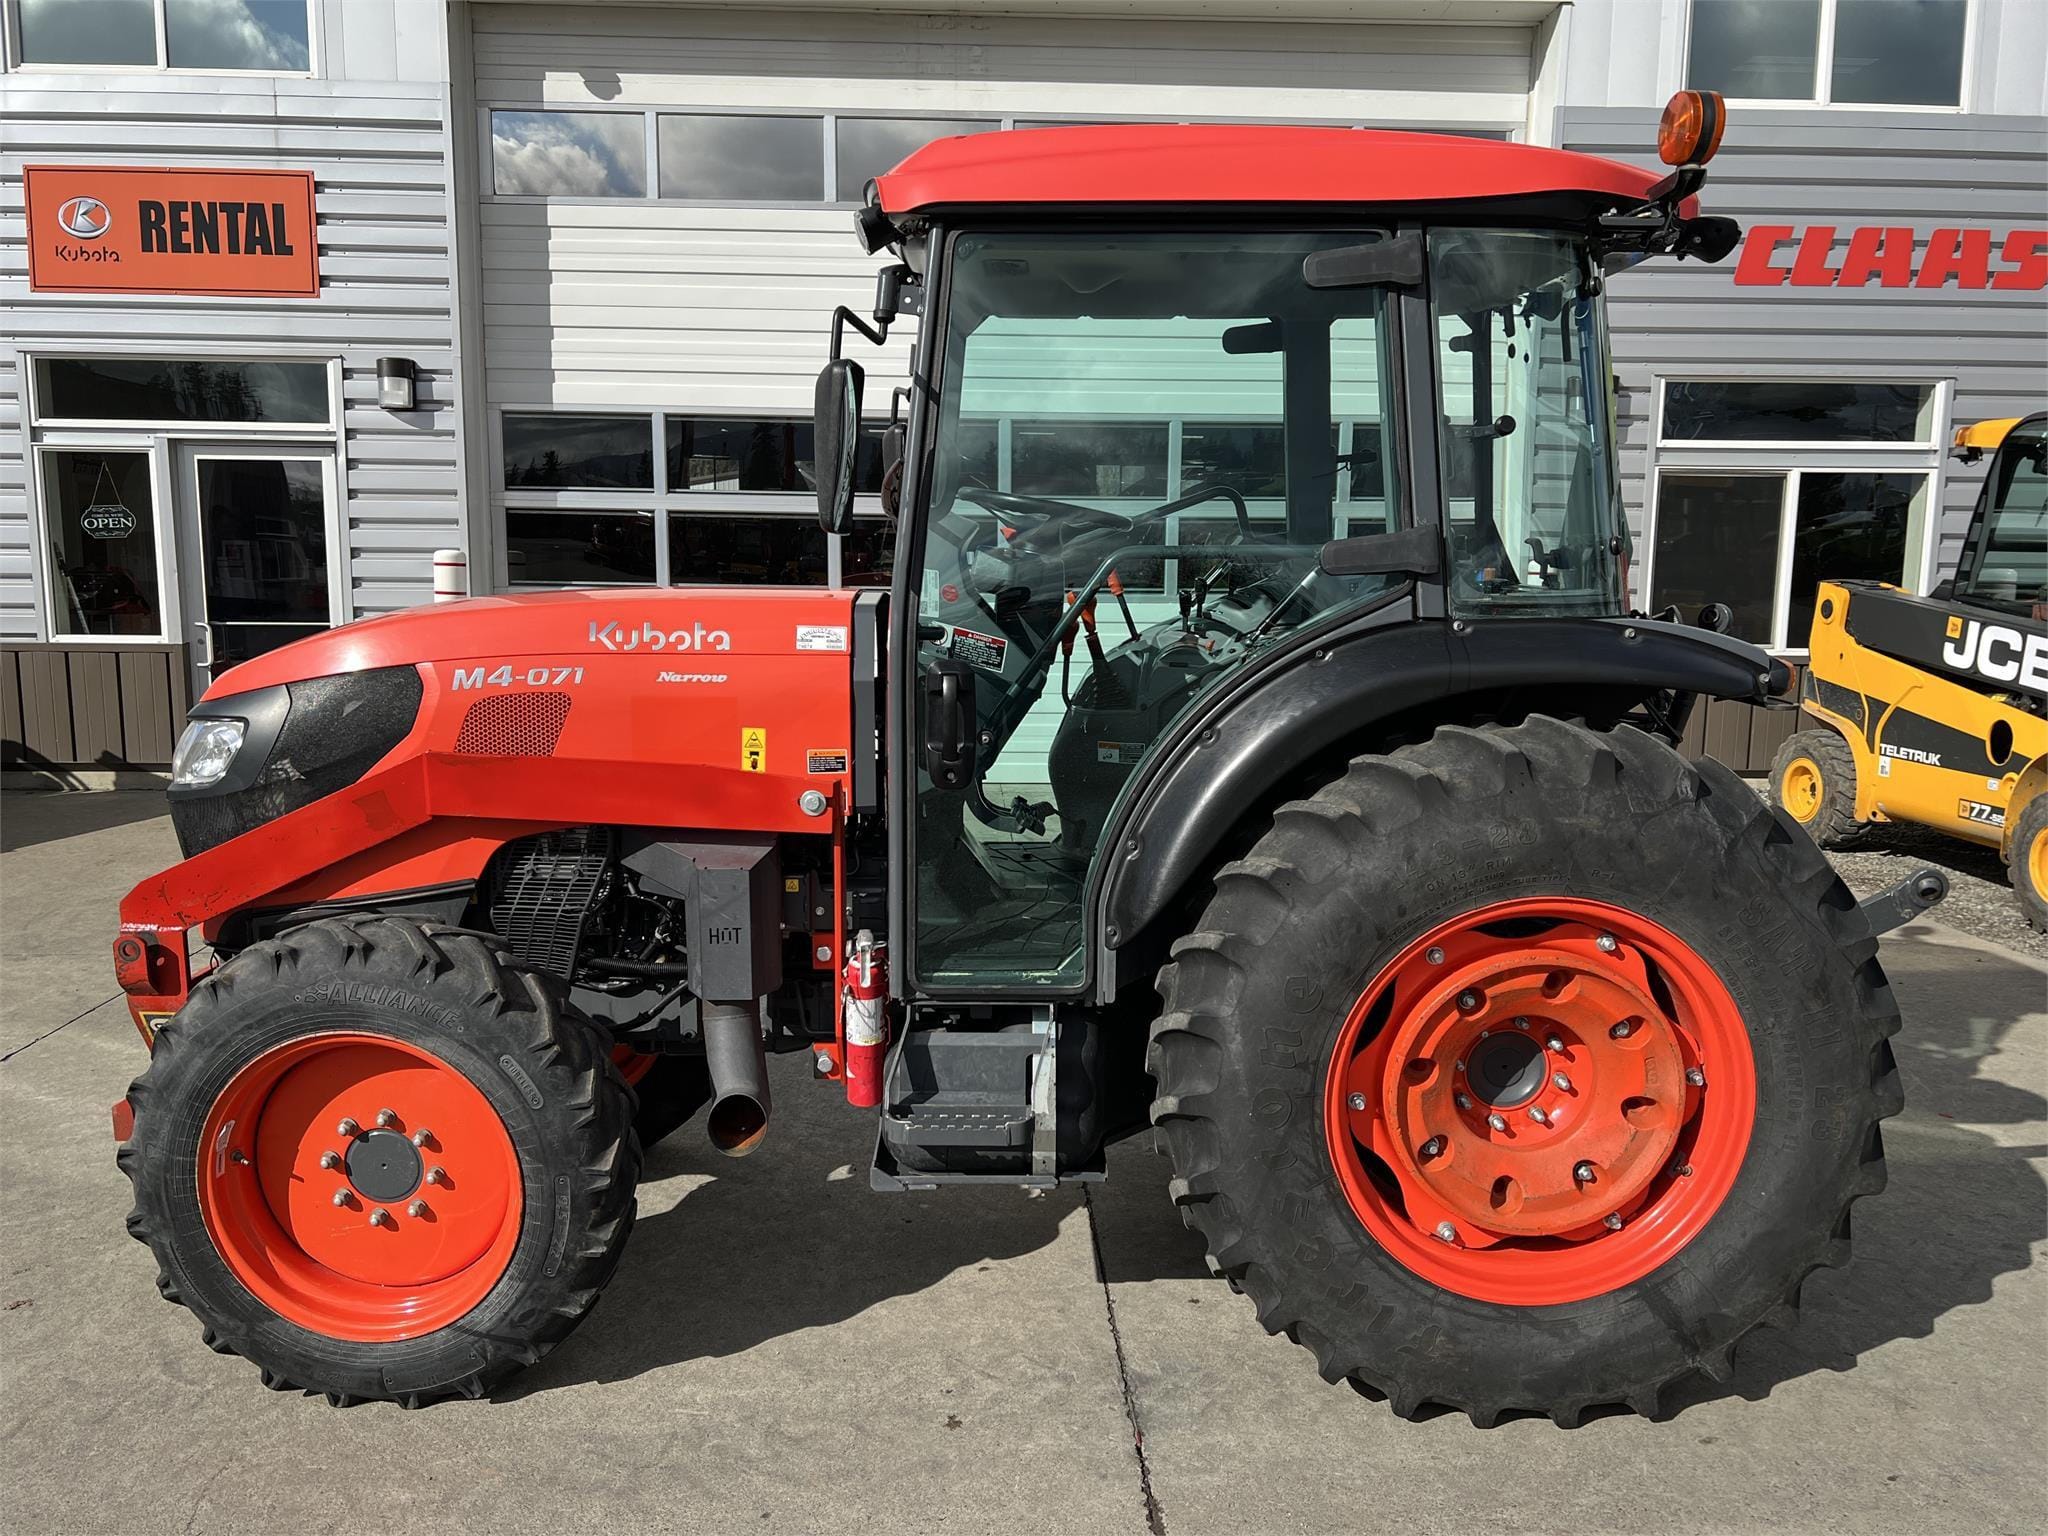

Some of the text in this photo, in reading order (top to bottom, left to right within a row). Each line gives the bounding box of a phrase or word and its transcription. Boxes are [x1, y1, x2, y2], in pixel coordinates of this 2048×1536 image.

[138, 199, 294, 256] RENTAL
[55, 245, 120, 263] Kubota
[1734, 225, 2048, 290] CLAAS
[83, 517, 133, 529] OPEN
[588, 621, 731, 651] Kubota
[1942, 620, 2048, 692] JCB
[451, 665, 584, 690] M4-071
[656, 671, 728, 683] Narrow
[1879, 743, 1942, 766] TELETRUK
[1486, 856, 1513, 871] RIM
[709, 927, 742, 945] HOT
[327, 981, 462, 1030] ALLIANCE
